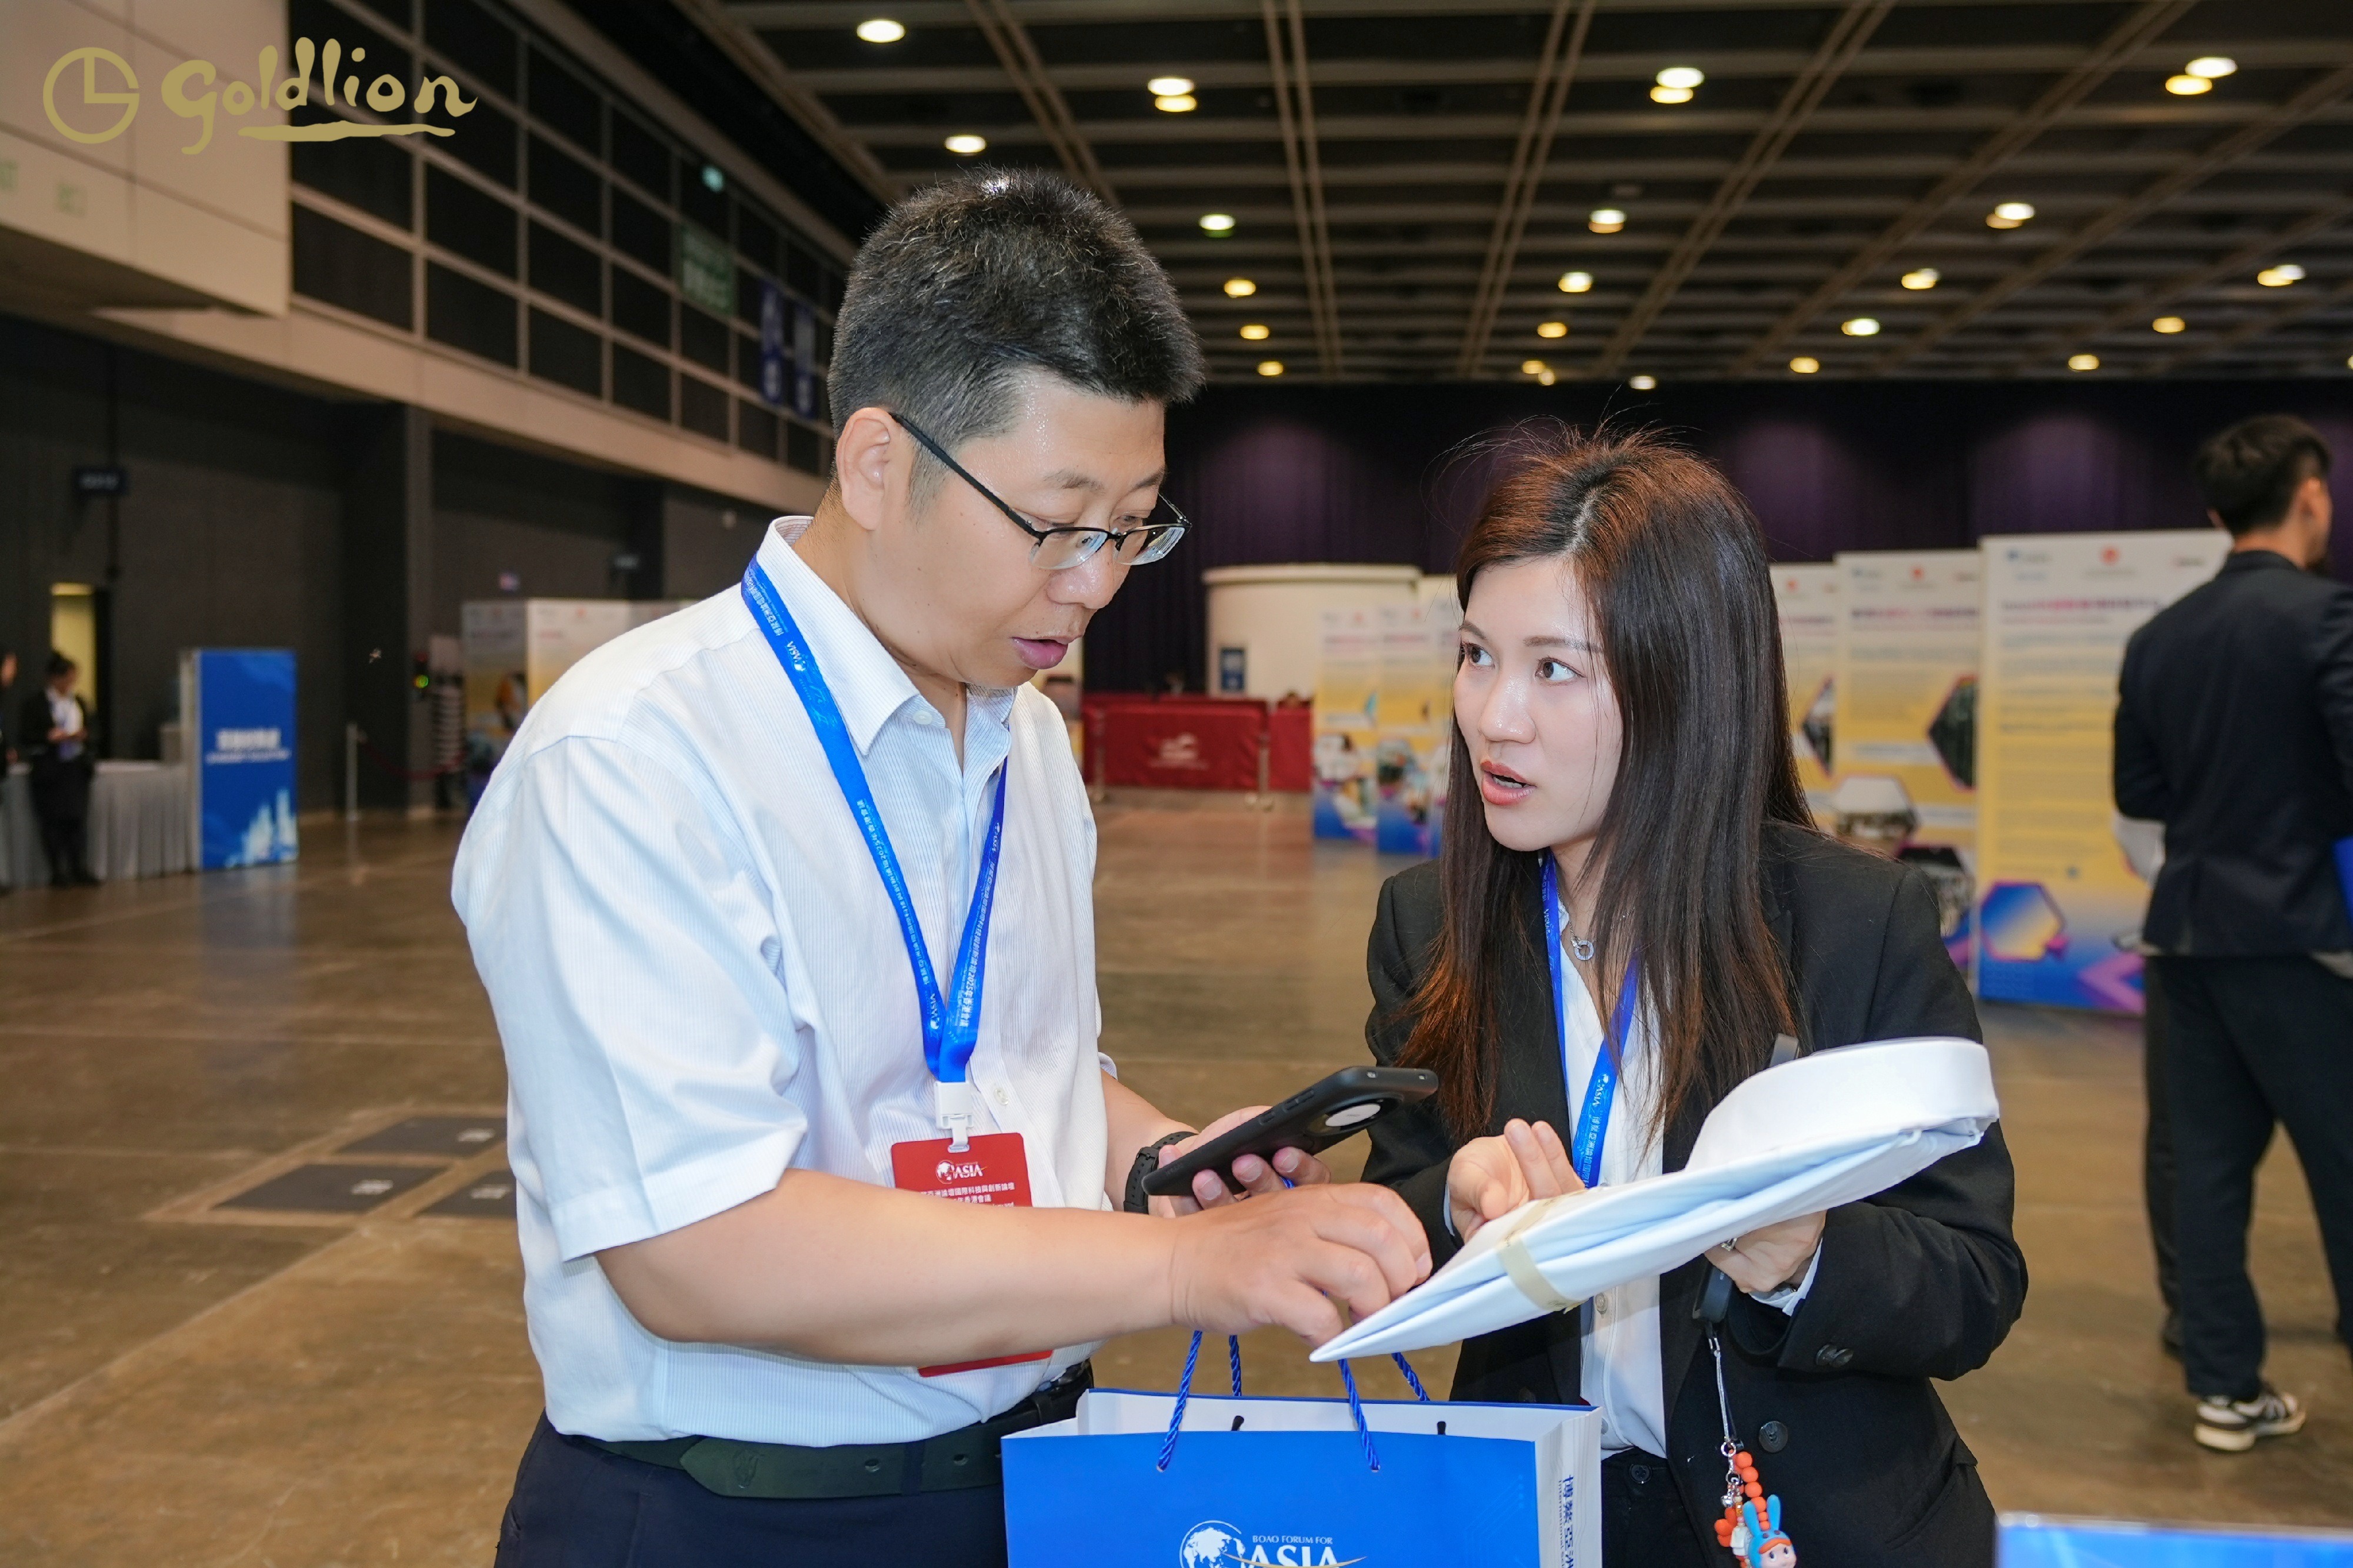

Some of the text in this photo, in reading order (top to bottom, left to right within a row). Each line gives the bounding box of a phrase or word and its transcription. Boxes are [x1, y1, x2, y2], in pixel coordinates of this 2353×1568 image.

[954, 1164, 983, 1179] ASIA
[1252, 1535, 1334, 1544] BOAO FORUM FOR
[1248, 1544, 1339, 1568] ASIA
